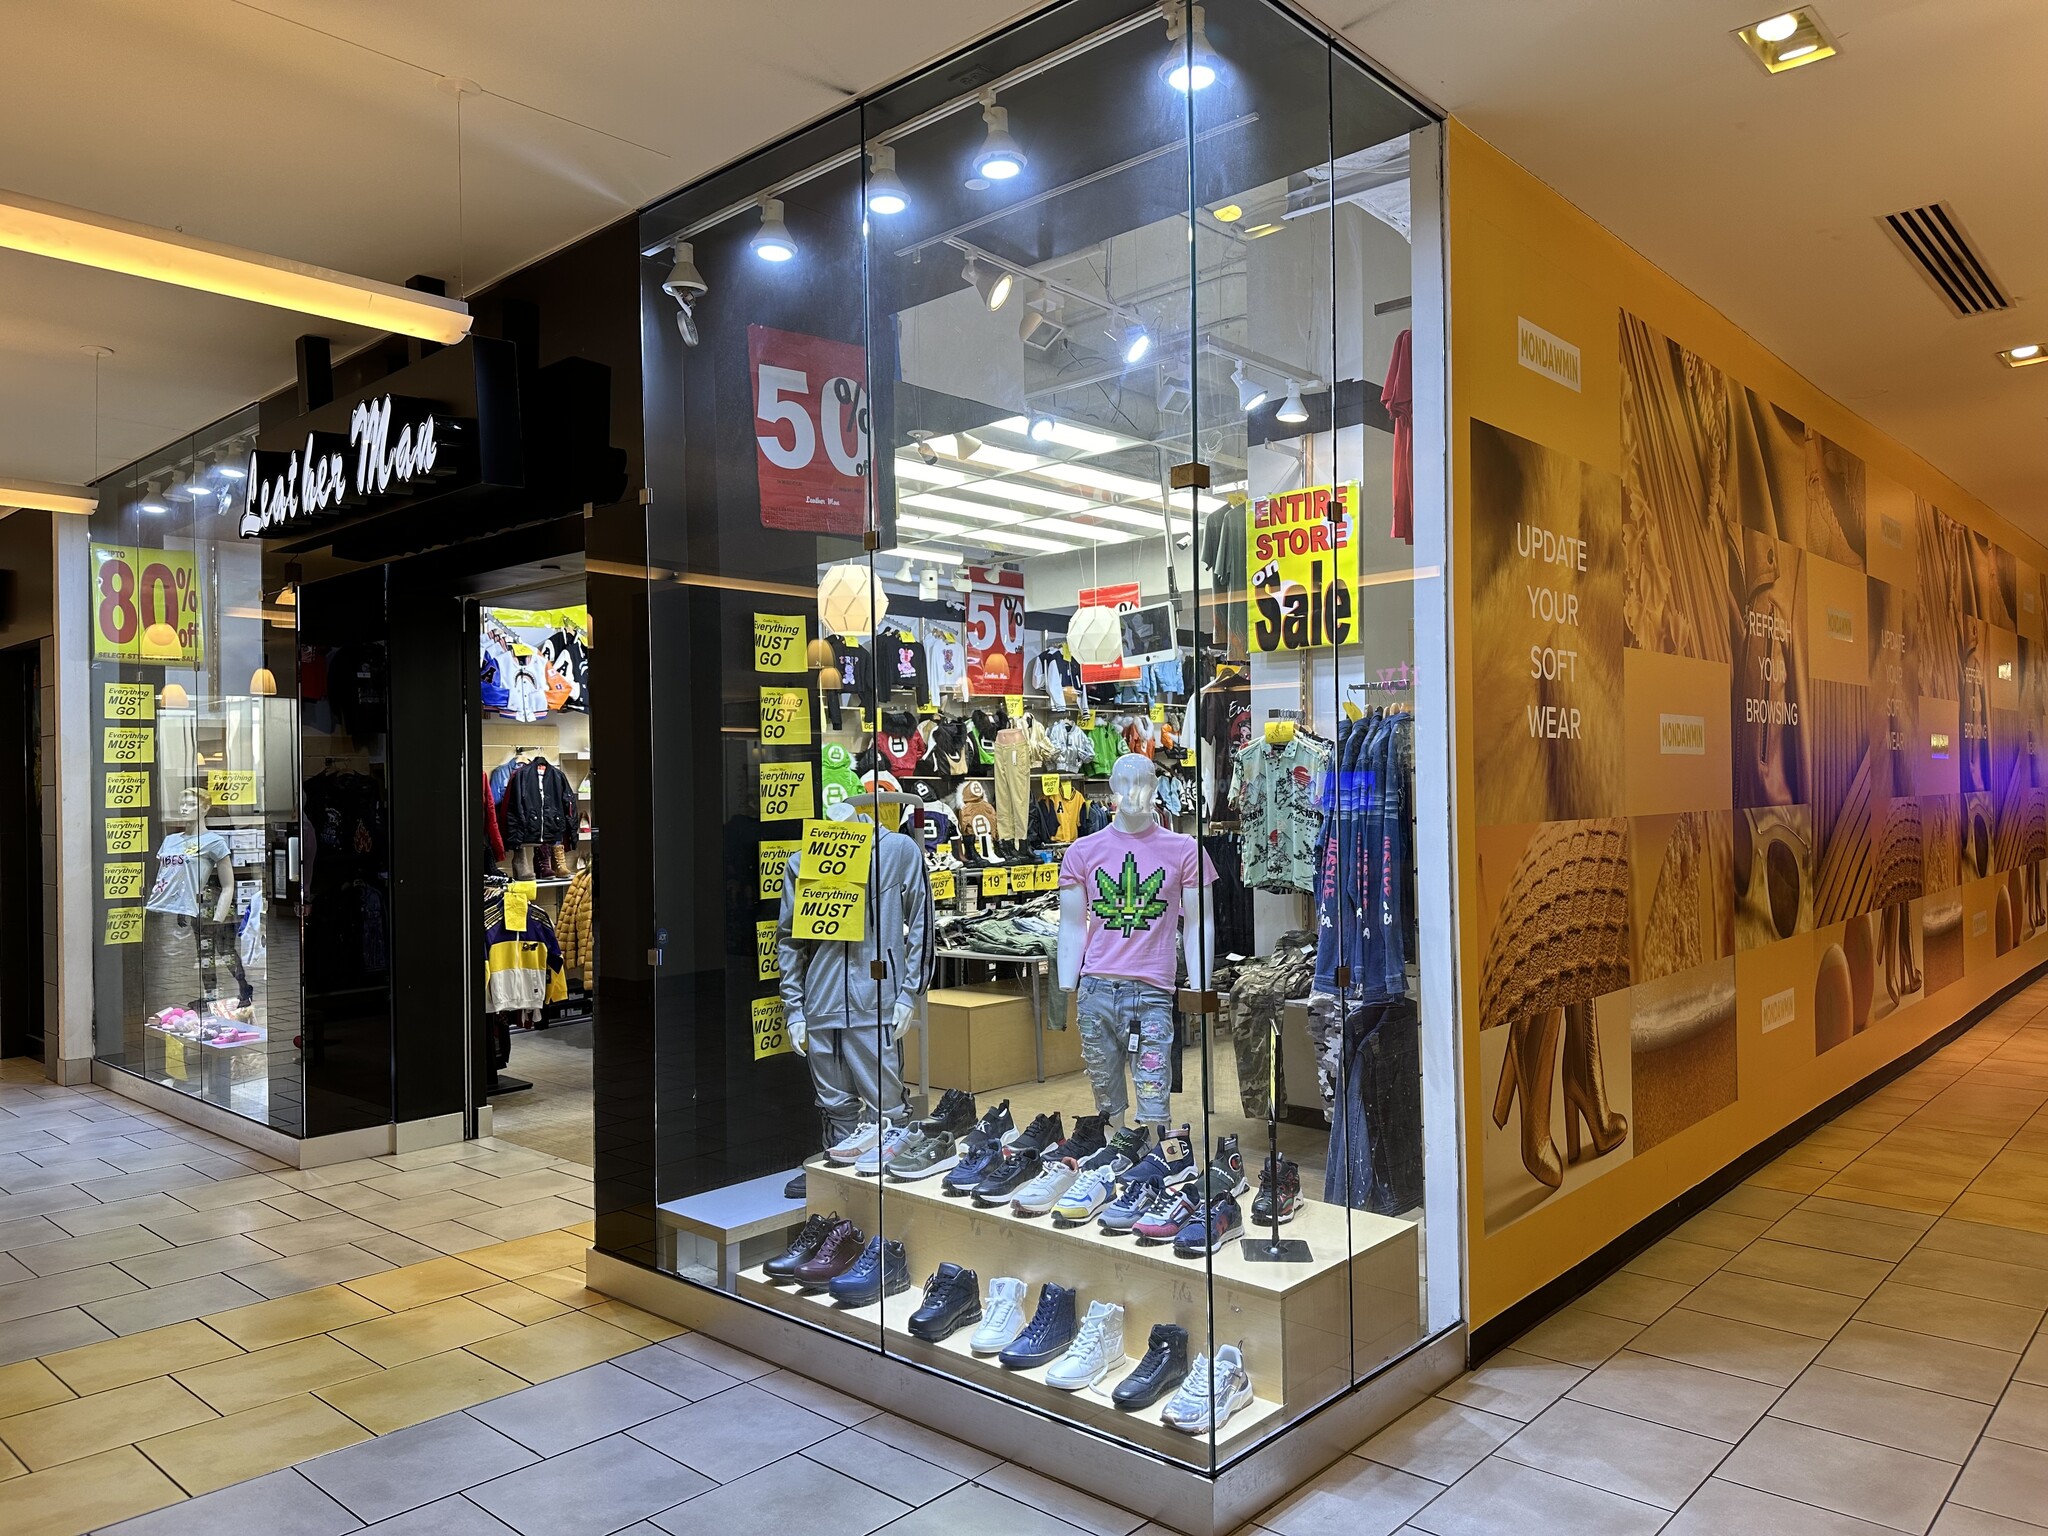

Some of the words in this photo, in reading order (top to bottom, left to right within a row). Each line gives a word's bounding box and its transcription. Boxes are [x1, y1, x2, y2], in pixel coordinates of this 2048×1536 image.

[1521, 327, 1579, 384] MONDAWMIN
[240, 432, 346, 538] Leather
[351, 393, 437, 496] Man
[1255, 486, 1348, 528] ENTIRE
[1256, 521, 1348, 560] STORE
[1517, 522, 1587, 572] UPDATE
[1252, 559, 1279, 586] on
[1255, 560, 1352, 651] Sale
[1527, 585, 1579, 626] YOUR
[754, 621, 799, 636] Everything
[1749, 611, 1792, 644] REFRESH
[755, 633, 794, 651] MUST
[760, 652, 782, 666] GO
[1530, 645, 1578, 682] SOFT
[1758, 656, 1787, 684] YOUR
[108, 688, 150, 697] Everything
[108, 696, 145, 706] MUST
[760, 696, 803, 708] verything
[116, 707, 136, 716] GO
[1746, 698, 1798, 726] BROWSING
[1527, 705, 1581, 739] WEAR
[108, 731, 149, 740] Everything
[764, 725, 785, 739] GO
[1662, 722, 1704, 748] MONDAWMIN
[108, 740, 145, 750] MUST
[115, 751, 136, 760] GO
[107, 776, 146, 784] Everything
[213, 774, 253, 783] Everything
[760, 771, 805, 783] Everything
[107, 784, 142, 794] MUST
[212, 782, 248, 792] MUST
[761, 784, 799, 798] MUST
[113, 796, 133, 805] GO
[220, 792, 239, 801] GO
[766, 801, 788, 814] GO
[106, 822, 144, 830] Everything
[107, 830, 141, 839] MUST
[810, 828, 867, 844] Everything
[112, 841, 131, 849] GO
[808, 841, 861, 859] MUST
[761, 849, 796, 860] verythin
[104, 867, 142, 875] Everything
[761, 861, 784, 876] US
[818, 860, 846, 875] GO
[105, 875, 137, 885] MUST
[763, 879, 783, 892] GO
[109, 886, 128, 895] GO
[802, 888, 859, 903] Everything
[934, 889, 944, 897] GO
[800, 902, 853, 918] MUST
[106, 920, 139, 931] MUST
[811, 920, 839, 935] GO
[110, 931, 130, 940] GO
[757, 930, 777, 940] Every
[758, 942, 778, 956] US
[761, 959, 780, 973] GO
[754, 1003, 784, 1016] Everyth
[760, 1035, 782, 1050] GO
